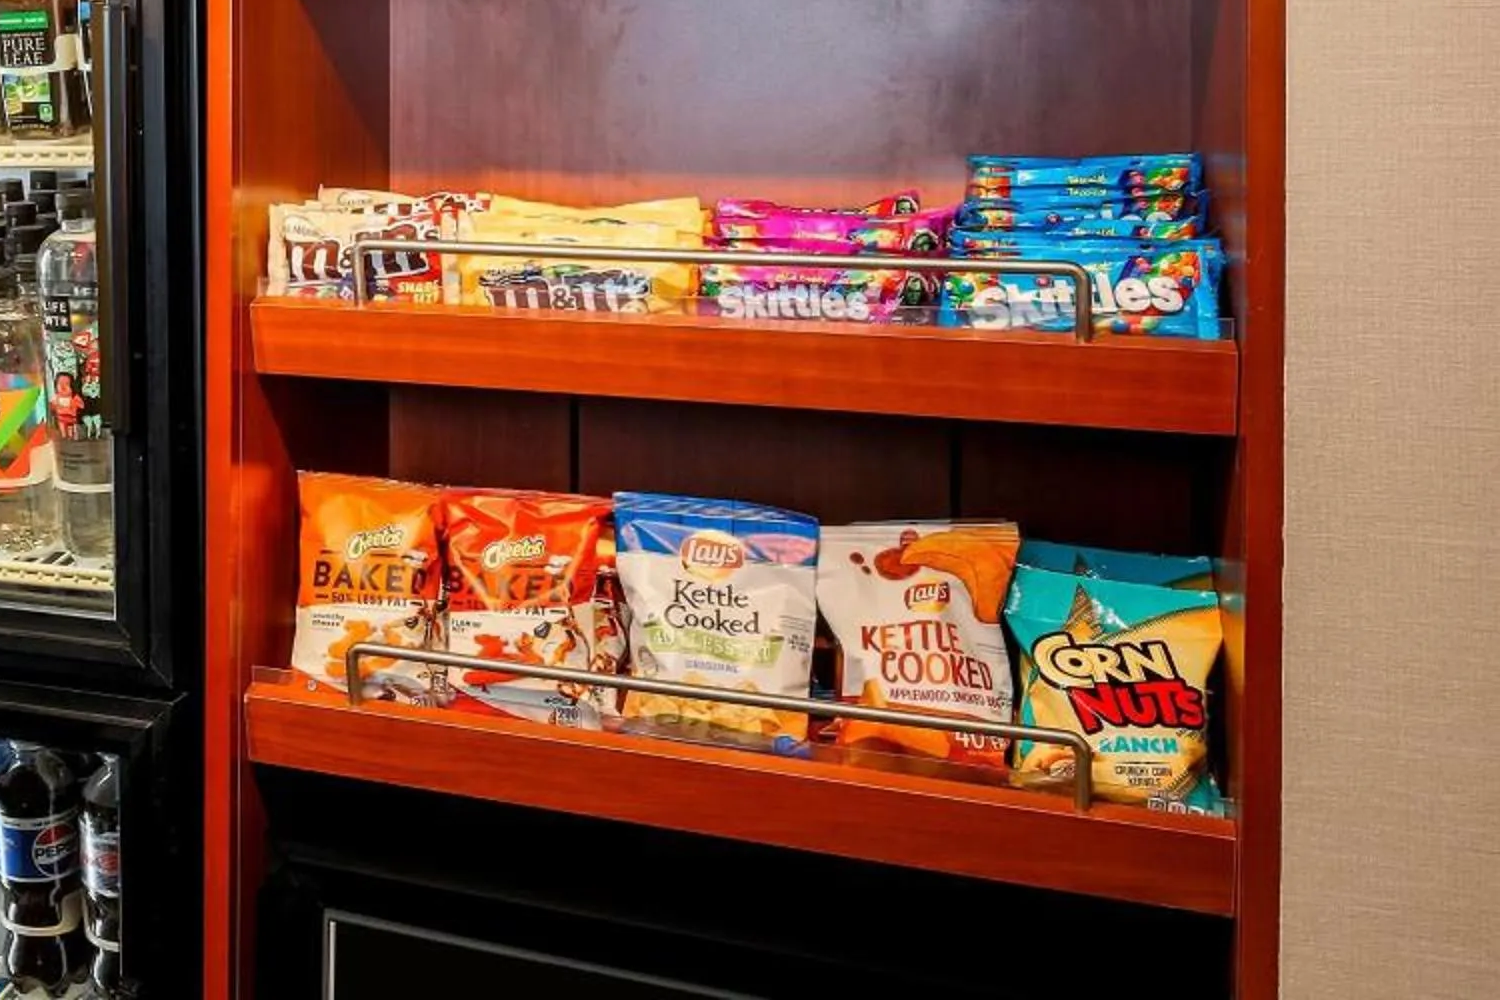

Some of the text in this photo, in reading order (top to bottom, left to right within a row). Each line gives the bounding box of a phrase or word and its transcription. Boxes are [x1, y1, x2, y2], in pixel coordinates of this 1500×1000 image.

[3, 37, 46, 52] PURE
[4, 52, 44, 67] LEAF
[43, 301, 68, 313] LIFE
[718, 282, 871, 321] Skittles
[345, 526, 404, 561] Cheetos
[481, 536, 546, 570] Cheetos
[313, 559, 428, 595] BAKED
[672, 579, 750, 609] Kettle
[907, 582, 949, 608] Lay's
[663, 603, 761, 637] Cooked
[861, 619, 965, 655] KETTLE
[880, 650, 993, 692] COOKED
[1034, 633, 1178, 688] CORN
[1068, 681, 1204, 735] NUTS
[1099, 735, 1179, 753] RANCH
